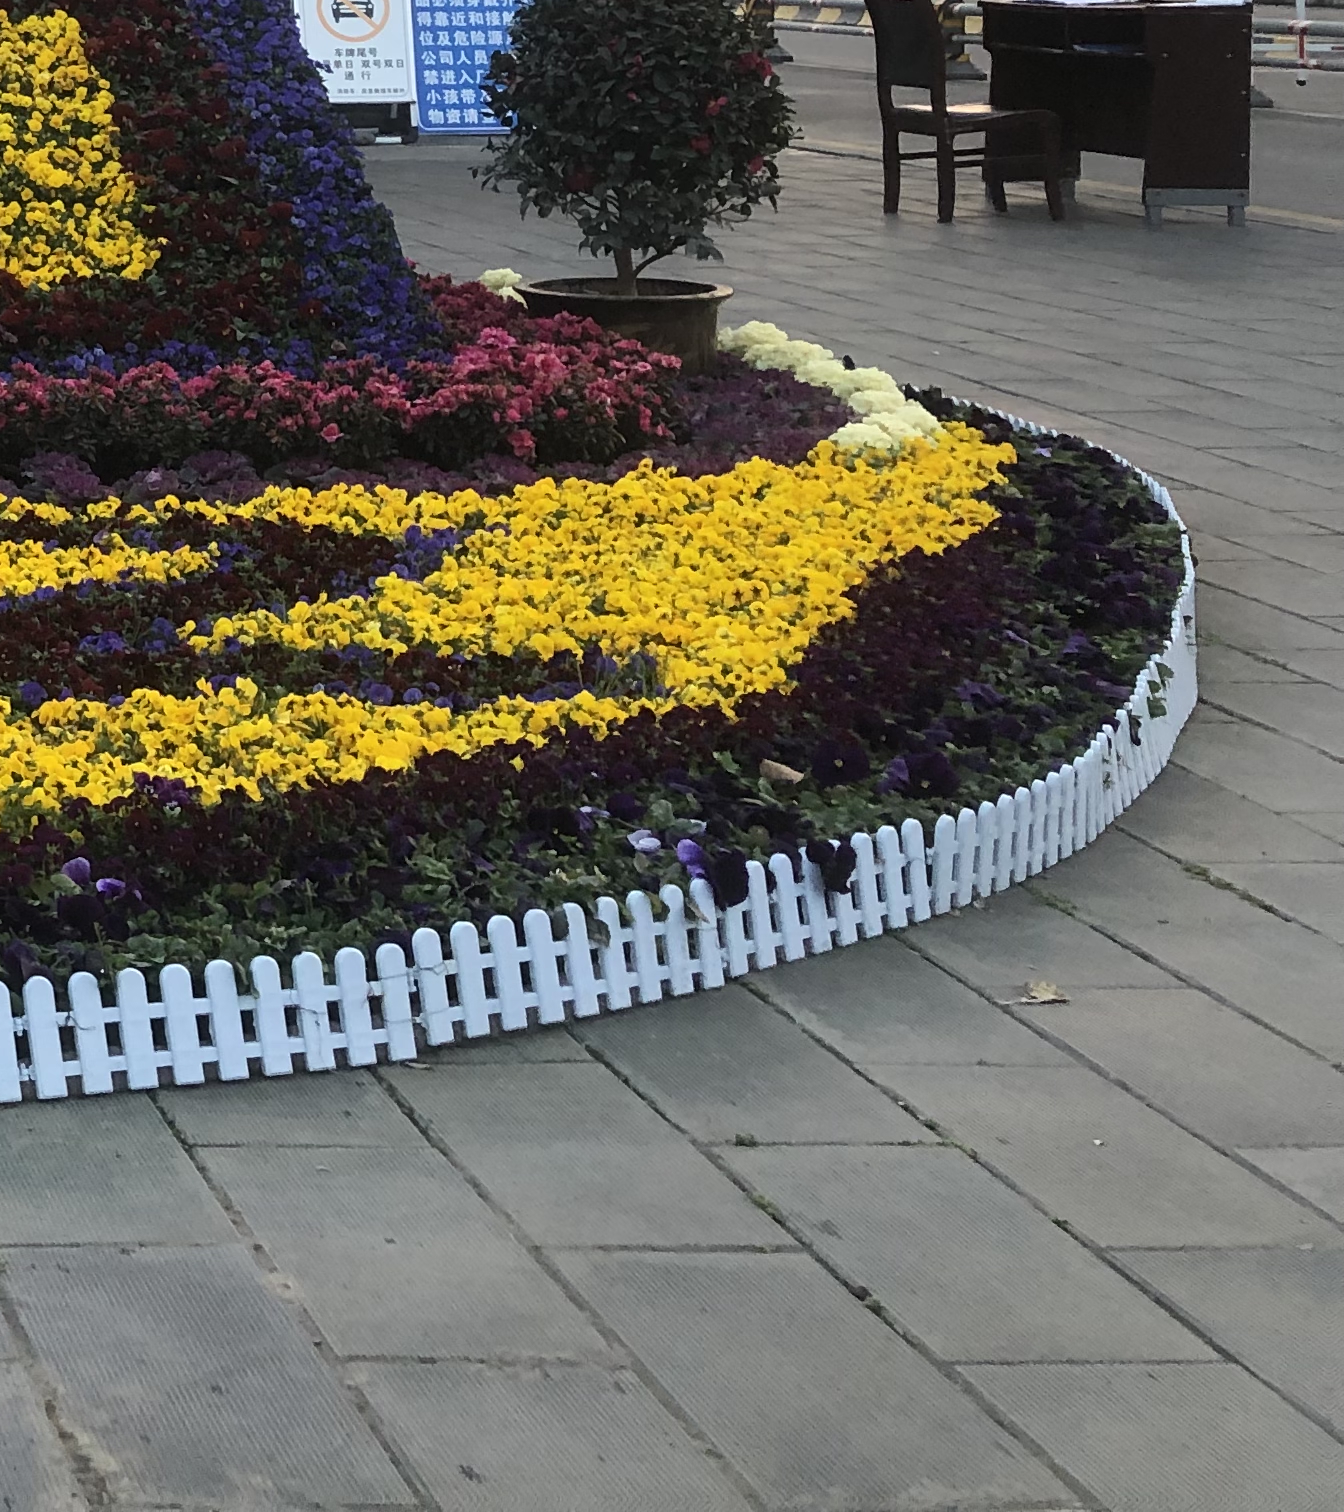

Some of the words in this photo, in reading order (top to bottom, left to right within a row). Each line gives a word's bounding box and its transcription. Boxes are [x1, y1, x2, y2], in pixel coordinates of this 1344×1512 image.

[419, 30, 512, 46] 位及危险源
[334, 47, 378, 58] 车牌尾号
[360, 59, 404, 69] 双号双日
[344, 70, 372, 81] 通行
